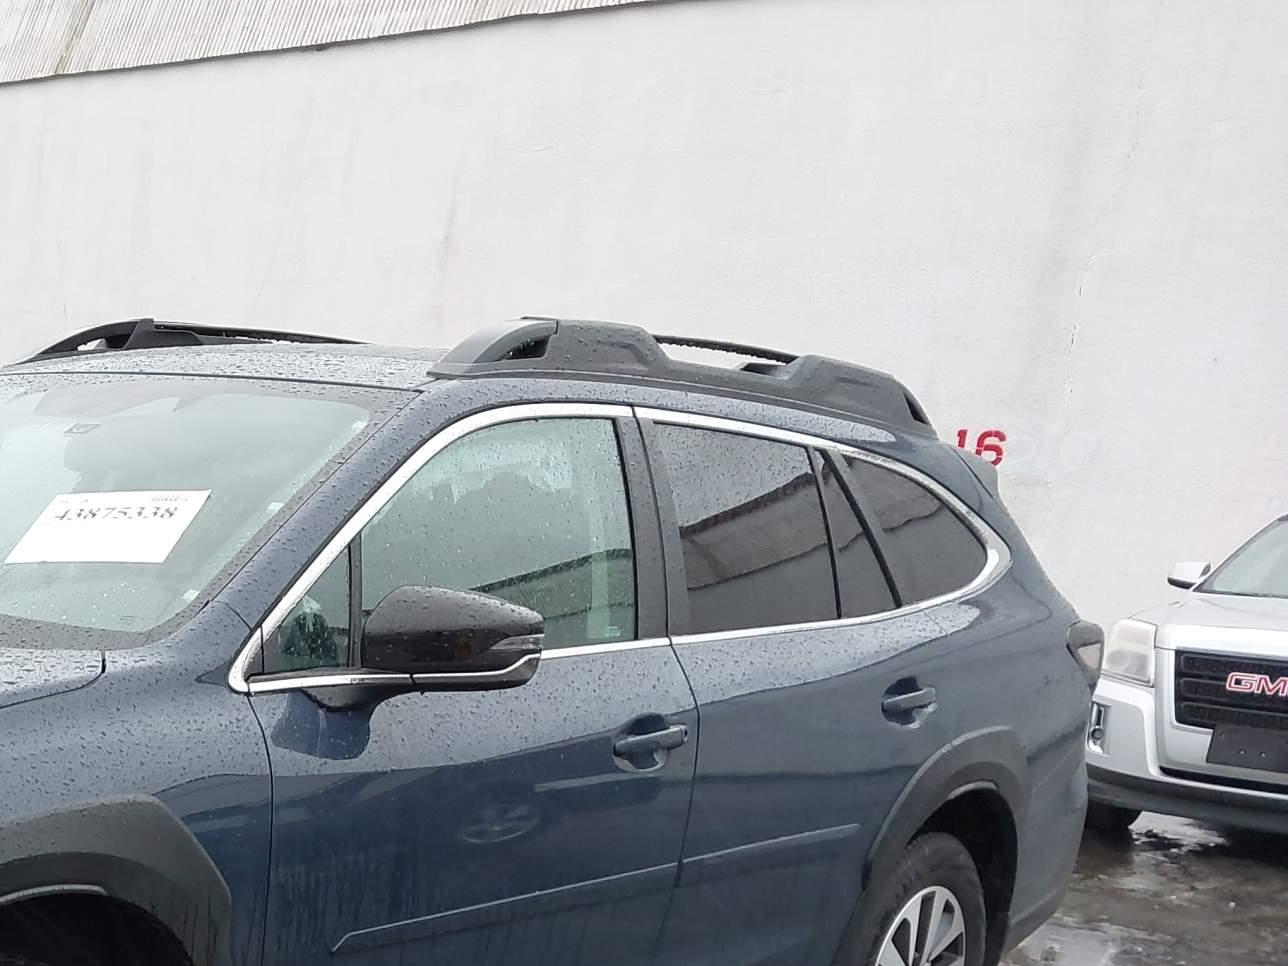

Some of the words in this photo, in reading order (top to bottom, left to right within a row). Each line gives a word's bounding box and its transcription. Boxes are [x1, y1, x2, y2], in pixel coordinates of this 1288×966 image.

[956, 428, 1007, 467] 16
[55, 506, 178, 521] 43875338
[1226, 672, 1288, 696] GM
